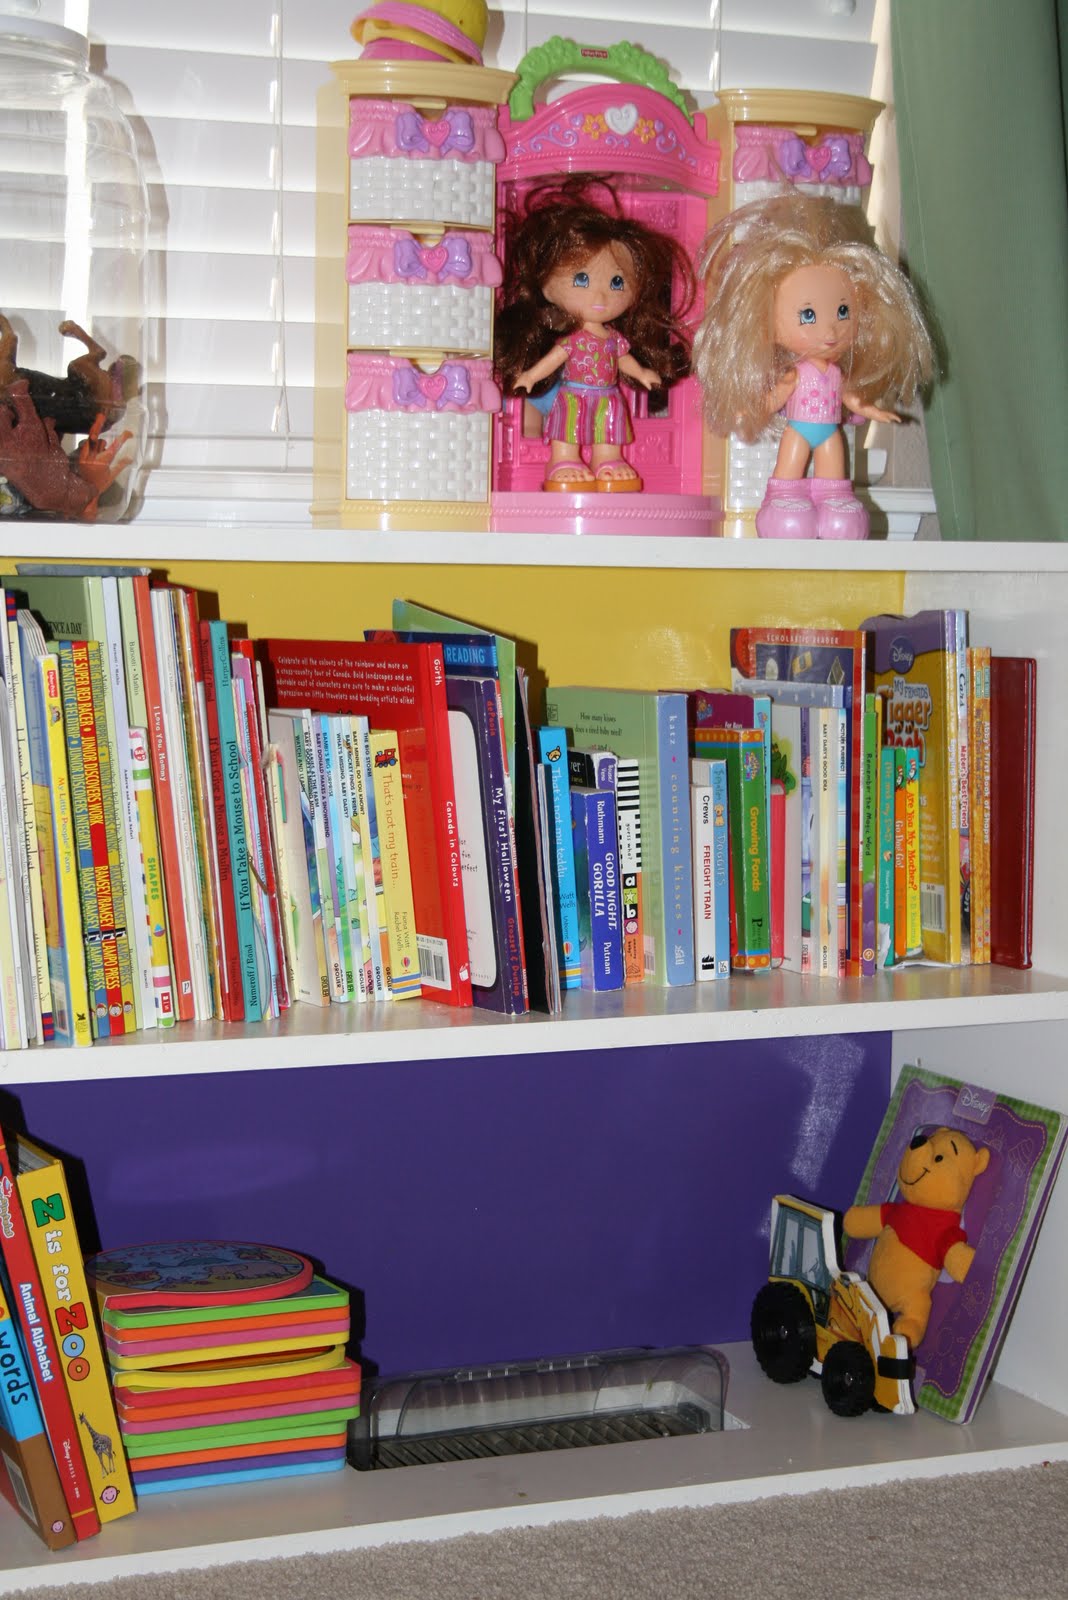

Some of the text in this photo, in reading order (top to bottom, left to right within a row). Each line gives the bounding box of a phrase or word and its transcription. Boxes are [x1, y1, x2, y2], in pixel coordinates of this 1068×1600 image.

[446, 647, 485, 663] READING
[767, 634, 839, 645] SCHOLASTIC READER
[892, 645, 913, 666] Disney
[129, 641, 140, 696] Barsotti Mathis
[218, 636, 229, 687] HarperCollins
[278, 656, 300, 665] Celebrate
[309, 657, 317, 665] the
[319, 658, 336, 667] colours
[337, 658, 344, 667] of
[345, 659, 353, 667] the
[355, 660, 375, 668] rainbow
[377, 661, 386, 669] and
[434, 658, 442, 686] Gürth
[48, 671, 56, 698] Fisher-Price
[894, 679, 929, 699] MY FRIENDS
[983, 721, 991, 750] Abby's
[158, 752, 167, 782] Mommy
[226, 741, 239, 779] School
[356, 769, 362, 779] DO
[960, 745, 968, 777] Mater's
[231, 782, 240, 795] to
[551, 767, 562, 823] That's not
[948, 738, 959, 829] Enjoying the Seasons
[59, 648, 107, 990] MY FANTASTIC FIELDTRIP JUNIOR DISCOVERS INTEGRITY RAMSEY/RAMSEY LAMPO PRESS
[72, 647, 121, 990] THE SUPER RED RACER JUNIOR DISCOVERS WORK RAMSEY/RAMSEY LAMPO PRESS
[88, 648, 133, 986] THE BIG BIRTHDAY SURPRISE JUNIOR DISCOVERS RAMSEY/RAMSEY LAMPO PRESS
[234, 798, 243, 836] Mouse
[322, 801, 330, 838] SNOWFRIEND
[597, 800, 606, 844] Rathmann
[669, 715, 683, 919] katz counting kisses
[703, 795, 711, 824] Crews
[984, 800, 991, 810] of
[382, 773, 400, 889] That's not my train...
[446, 801, 459, 887] Canada in Colours
[492, 787, 511, 902] My First Halloween
[895, 819, 904, 868] Go Dog Go!
[905, 791, 917, 891] Are You My Mother?
[983, 812, 991, 844] Shapes
[237, 848, 247, 877] Take
[716, 833, 726, 886] DOGGIES
[748, 806, 762, 892] Growing Foods
[147, 857, 159, 900] SHAPES
[239, 878, 250, 900] You
[593, 862, 604, 917] GORILLA
[605, 852, 617, 931] GOOD NIGHT,
[703, 845, 712, 920] FREIGHT TRAIN
[240, 901, 251, 911] If
[394, 911, 402, 932] Rachel
[244, 944, 258, 1006] Numeroff Bond
[507, 917, 521, 997] Grosset Dunlap
[603, 941, 612, 975] Putnam
[385, 966, 393, 992] GROLIER
[961, 1087, 990, 1117] Disney
[31, 1193, 91, 1382] Z is for ZOO
[19, 1283, 54, 1382] Animal Alphabet
[0, 1331, 29, 1405] words
[62, 1438, 76, 1478] Disney PRESS
